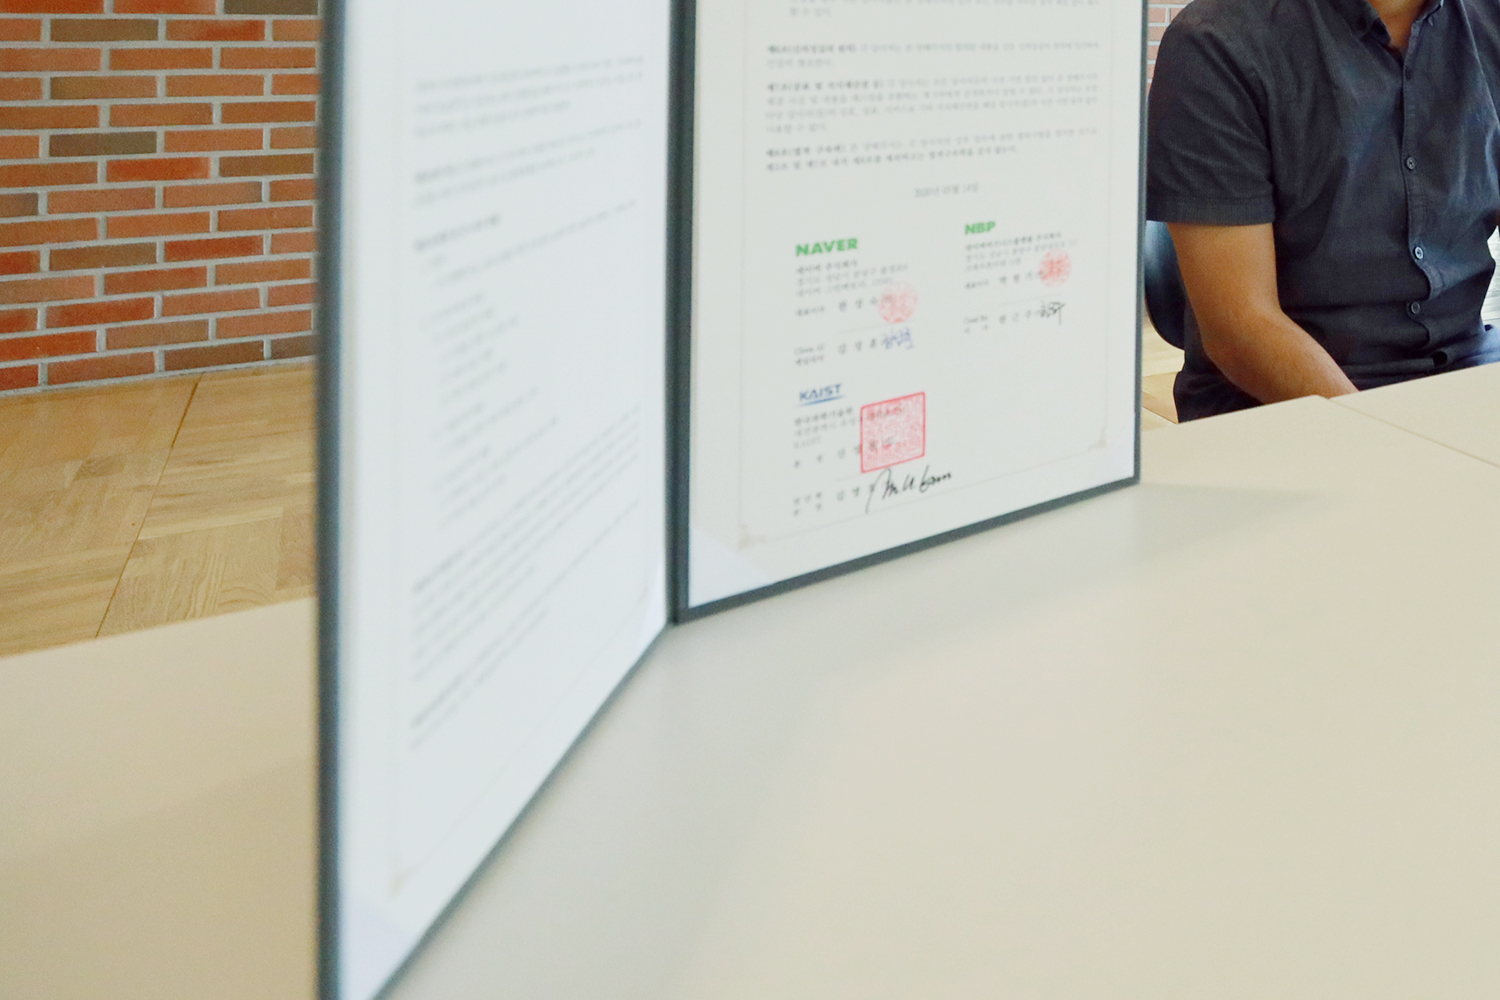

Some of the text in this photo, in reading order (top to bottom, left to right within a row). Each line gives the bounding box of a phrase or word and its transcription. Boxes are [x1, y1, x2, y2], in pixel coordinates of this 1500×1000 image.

[965, 221, 996, 235] NBP
[796, 238, 859, 257] NAVER
[799, 383, 842, 401] KAIST
